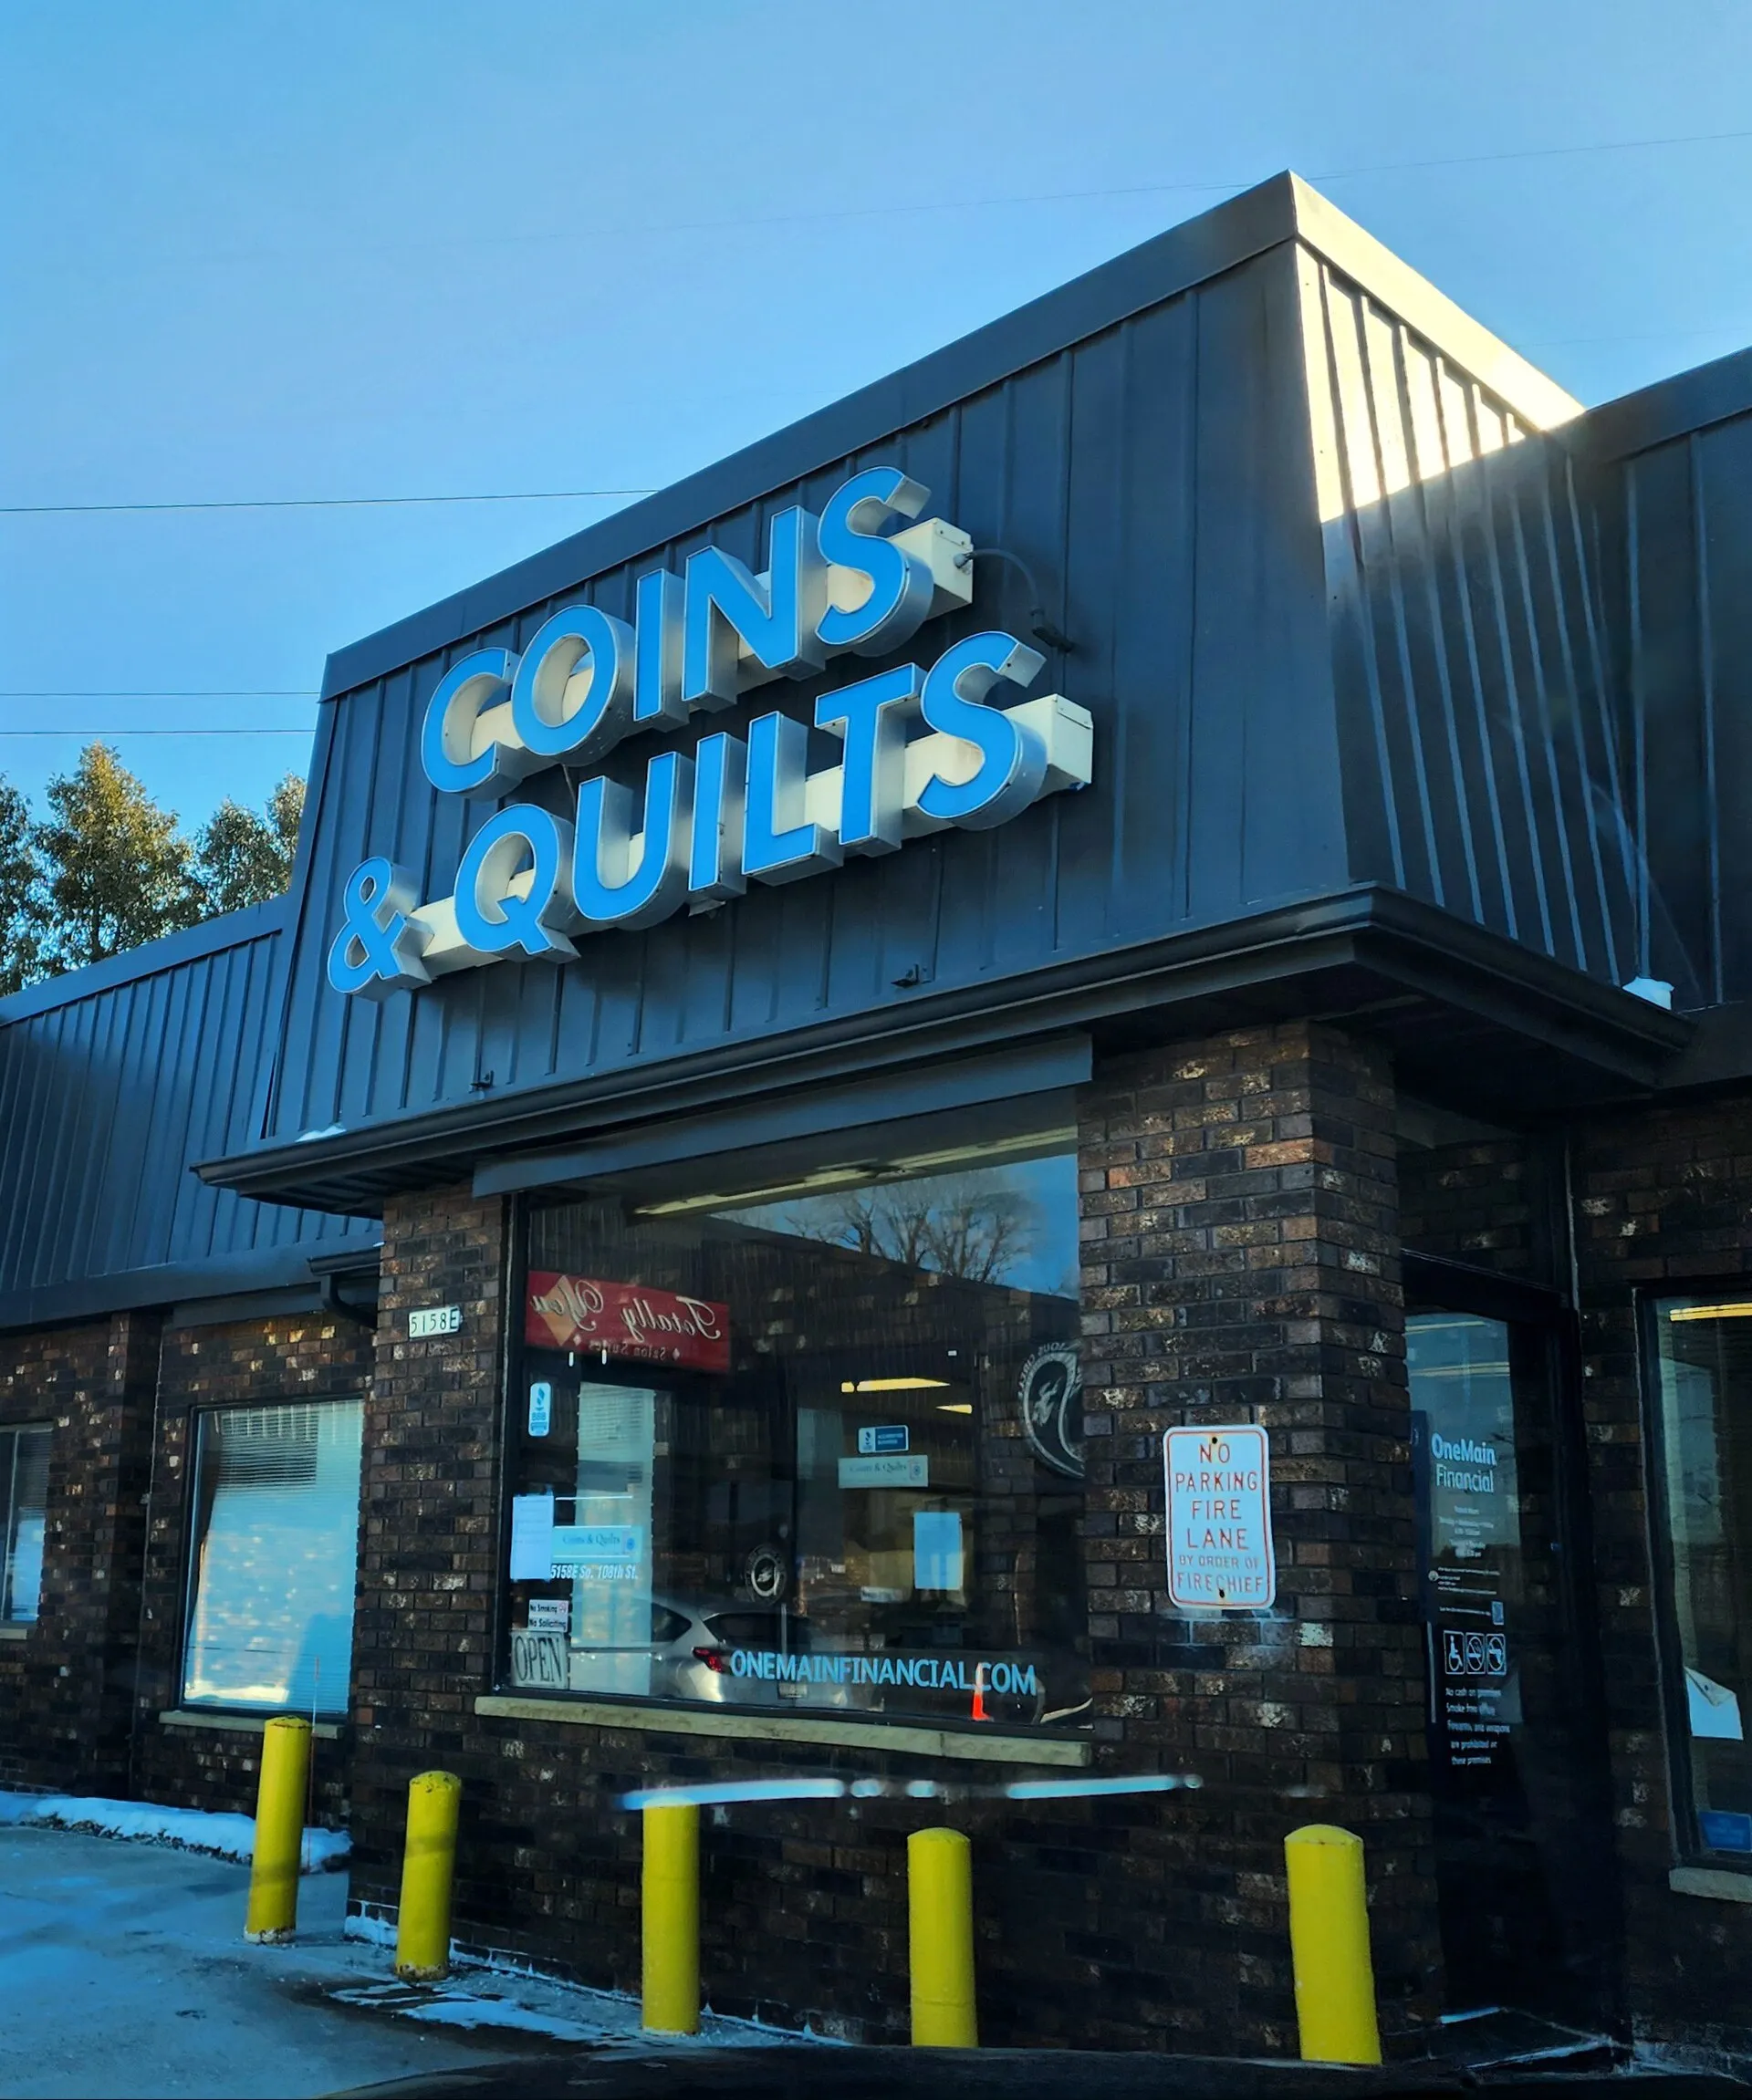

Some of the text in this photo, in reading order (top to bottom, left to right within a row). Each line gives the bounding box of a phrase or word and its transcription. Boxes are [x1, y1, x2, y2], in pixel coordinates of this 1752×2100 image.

[422, 466, 912, 793] COINS
[328, 630, 1022, 993] & QUILTS
[411, 1307, 458, 1335] 5158E
[1199, 1443, 1231, 1463] NO
[1432, 1432, 1497, 1466] OneMain
[1175, 1471, 1257, 1492] PARKING
[1435, 1463, 1494, 1492] Financial
[1192, 1499, 1242, 1520] FIRE
[1187, 1528, 1249, 1550] LANE
[550, 1565, 579, 1579] 5158E
[1179, 1554, 1194, 1565] BY
[1198, 1554, 1239, 1569] ORDER
[529, 1618, 537, 1627] No
[515, 1636, 562, 1682] OPEN
[730, 1649, 1037, 1696] ONEMAINFINANCIALCOM
